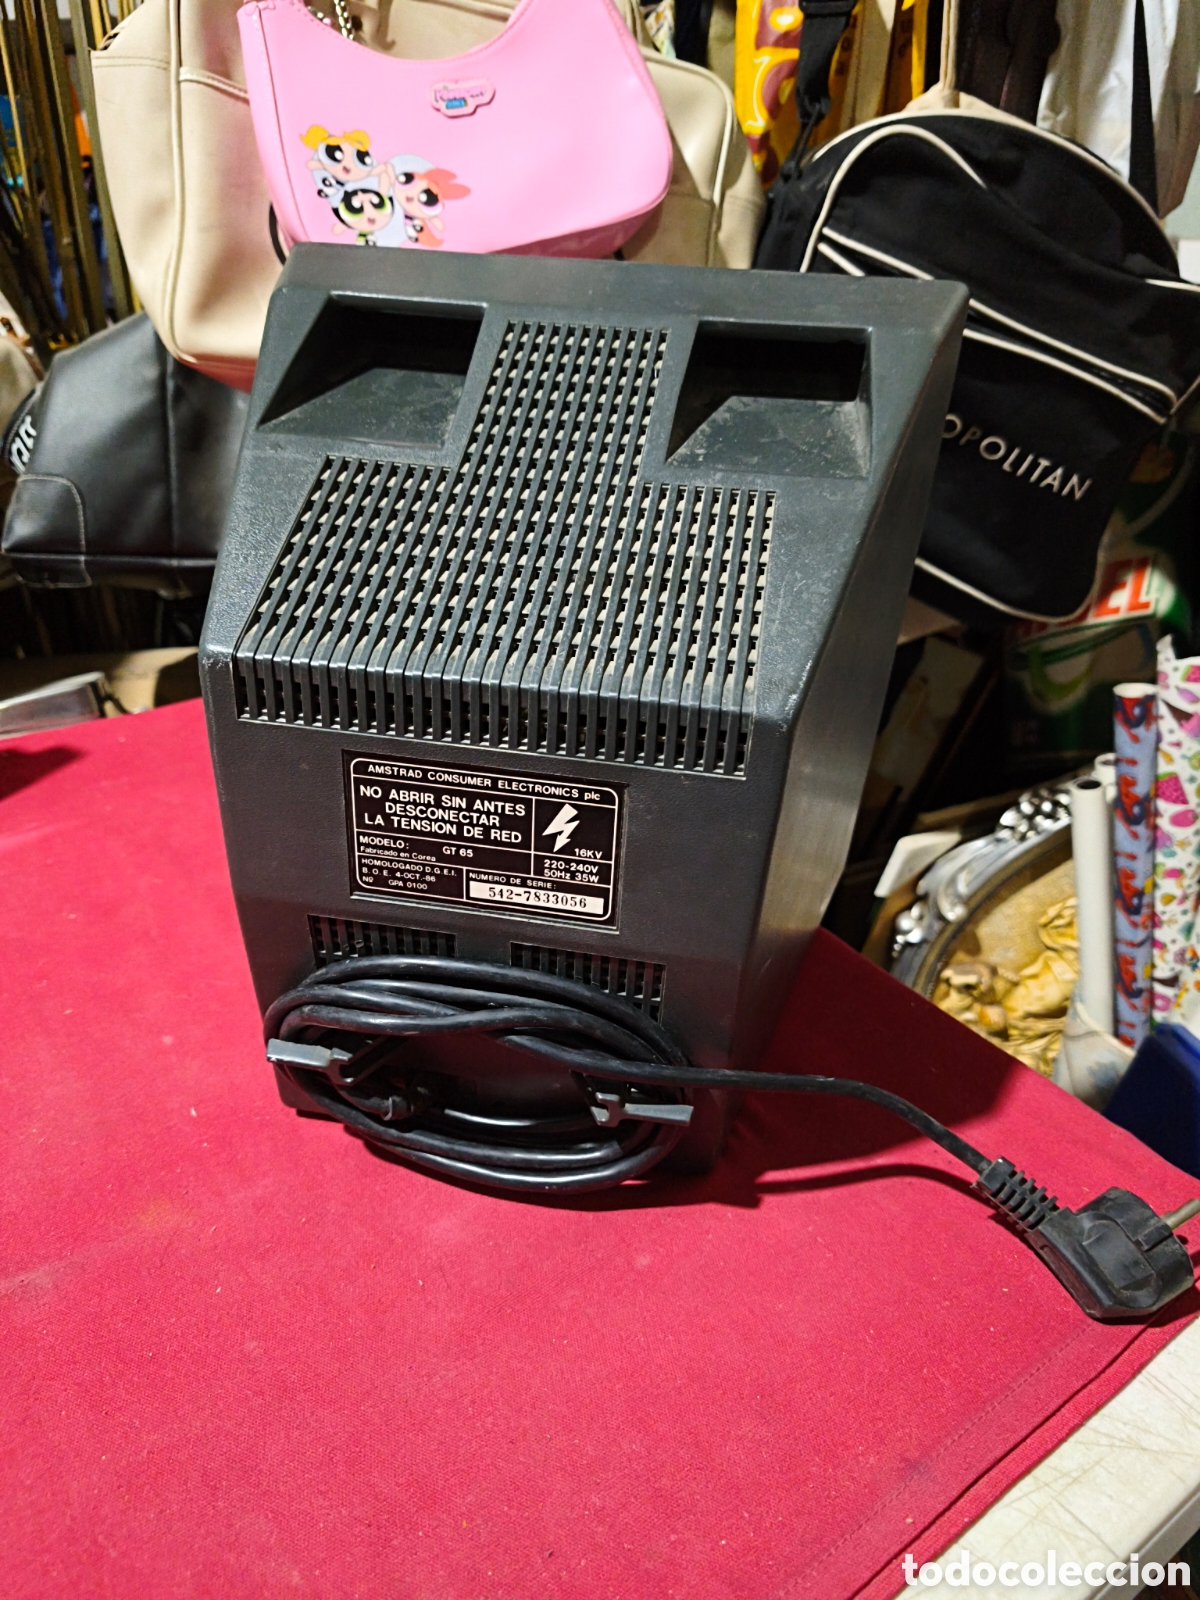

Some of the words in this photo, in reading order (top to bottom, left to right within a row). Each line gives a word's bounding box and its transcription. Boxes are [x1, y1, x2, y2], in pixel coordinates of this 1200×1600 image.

[367, 764, 423, 779] AMSTRAD
[427, 772, 492, 788] CONSUMER
[498, 780, 579, 798] ELECTRONICS
[584, 791, 601, 801] plc
[360, 785, 382, 799] NO
[388, 789, 435, 805] ABRIR
[441, 795, 467, 809] SIN
[473, 799, 526, 816] ANTES
[385, 802, 500, 827] DESCONECTAR
[364, 813, 385, 826] LA
[390, 816, 457, 835] TENSION
[463, 826, 484, 839] DE
[490, 829, 522, 843] RED
[359, 835, 409, 850] MODELO:
[442, 846, 457, 855] GT
[459, 848, 474, 857] 65
[360, 846, 398, 857] Fabricado
[411, 853, 436, 862] Corea
[574, 848, 603, 859] 16KV
[361, 858, 423, 872] HOMOLOGADO
[543, 859, 599, 874] 220-240V
[388, 879, 404, 887] GPA
[469, 872, 507, 883] NUMERO
[510, 877, 522, 885] DE
[526, 880, 557, 890] SERIE:
[543, 869, 571, 880] 50Hz
[575, 872, 600, 883] 35W
[488, 886, 587, 909] 542-7833056
